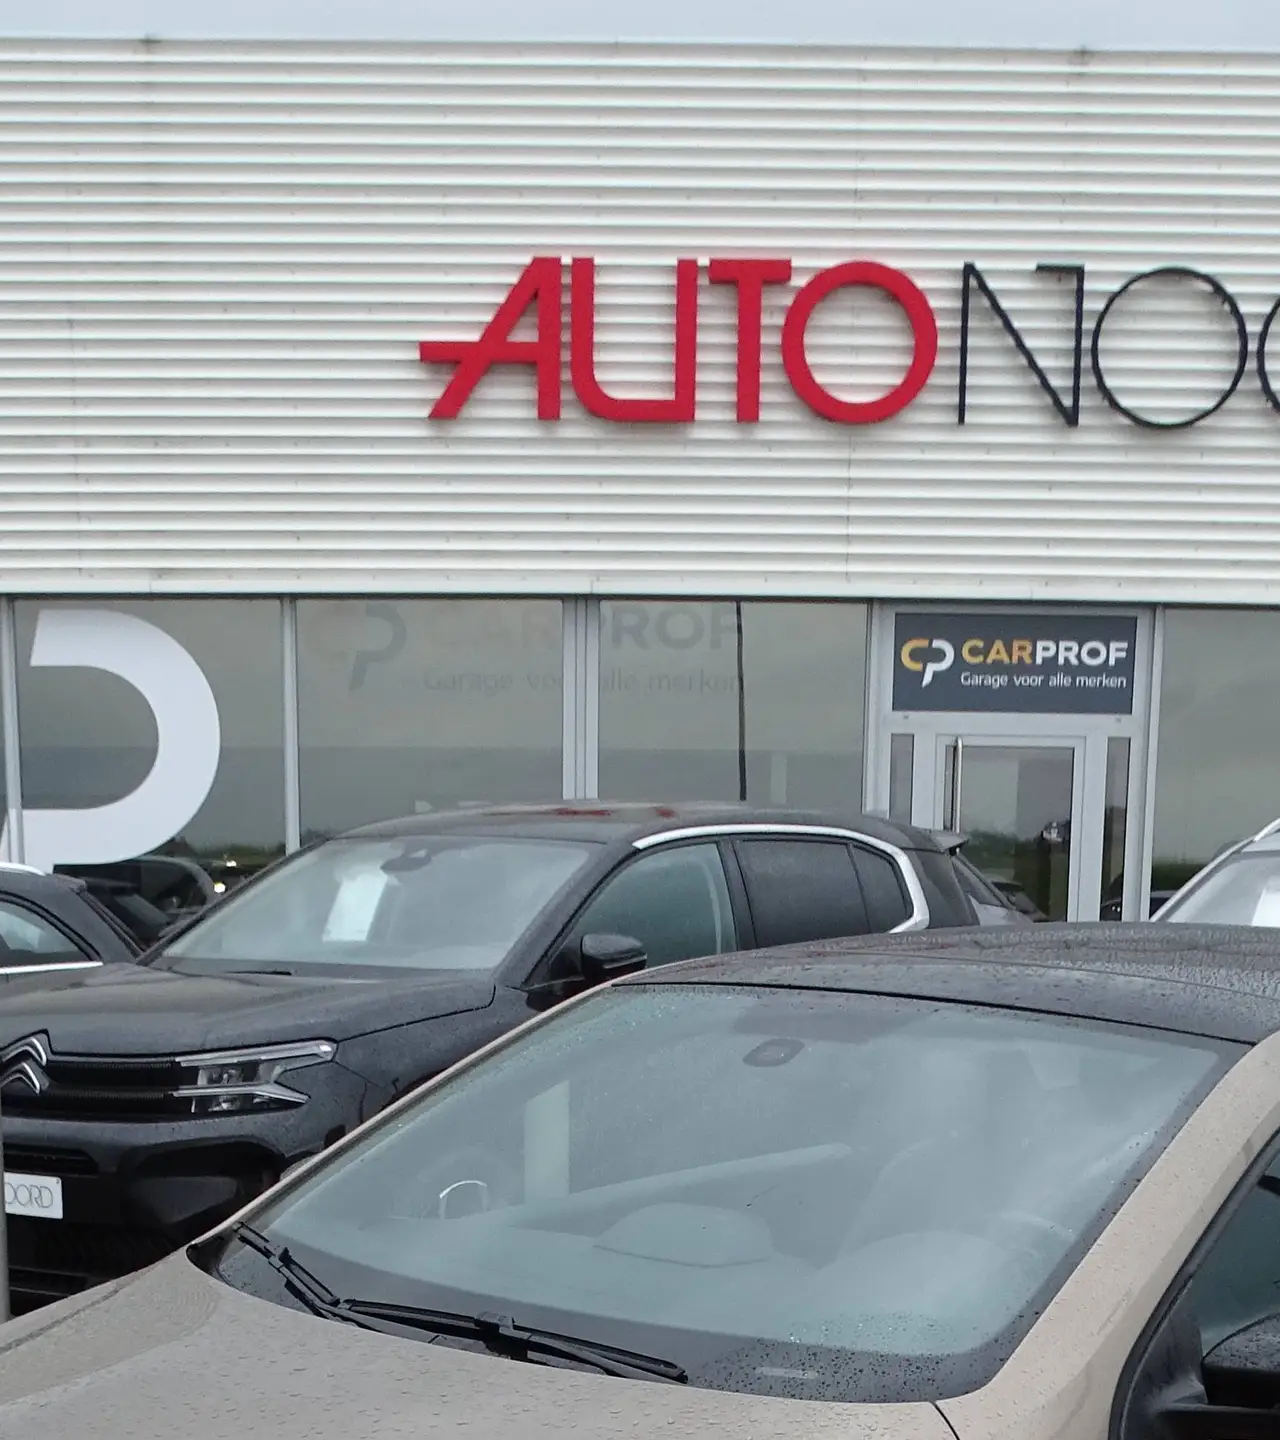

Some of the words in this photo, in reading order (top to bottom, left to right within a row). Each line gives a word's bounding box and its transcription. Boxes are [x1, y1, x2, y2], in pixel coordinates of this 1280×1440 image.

[961, 638, 1129, 667] CARPROF
[960, 671, 1008, 690] Garage
[1014, 674, 1044, 688] voor
[1049, 672, 1071, 688] alle
[1076, 673, 1128, 689] merken
